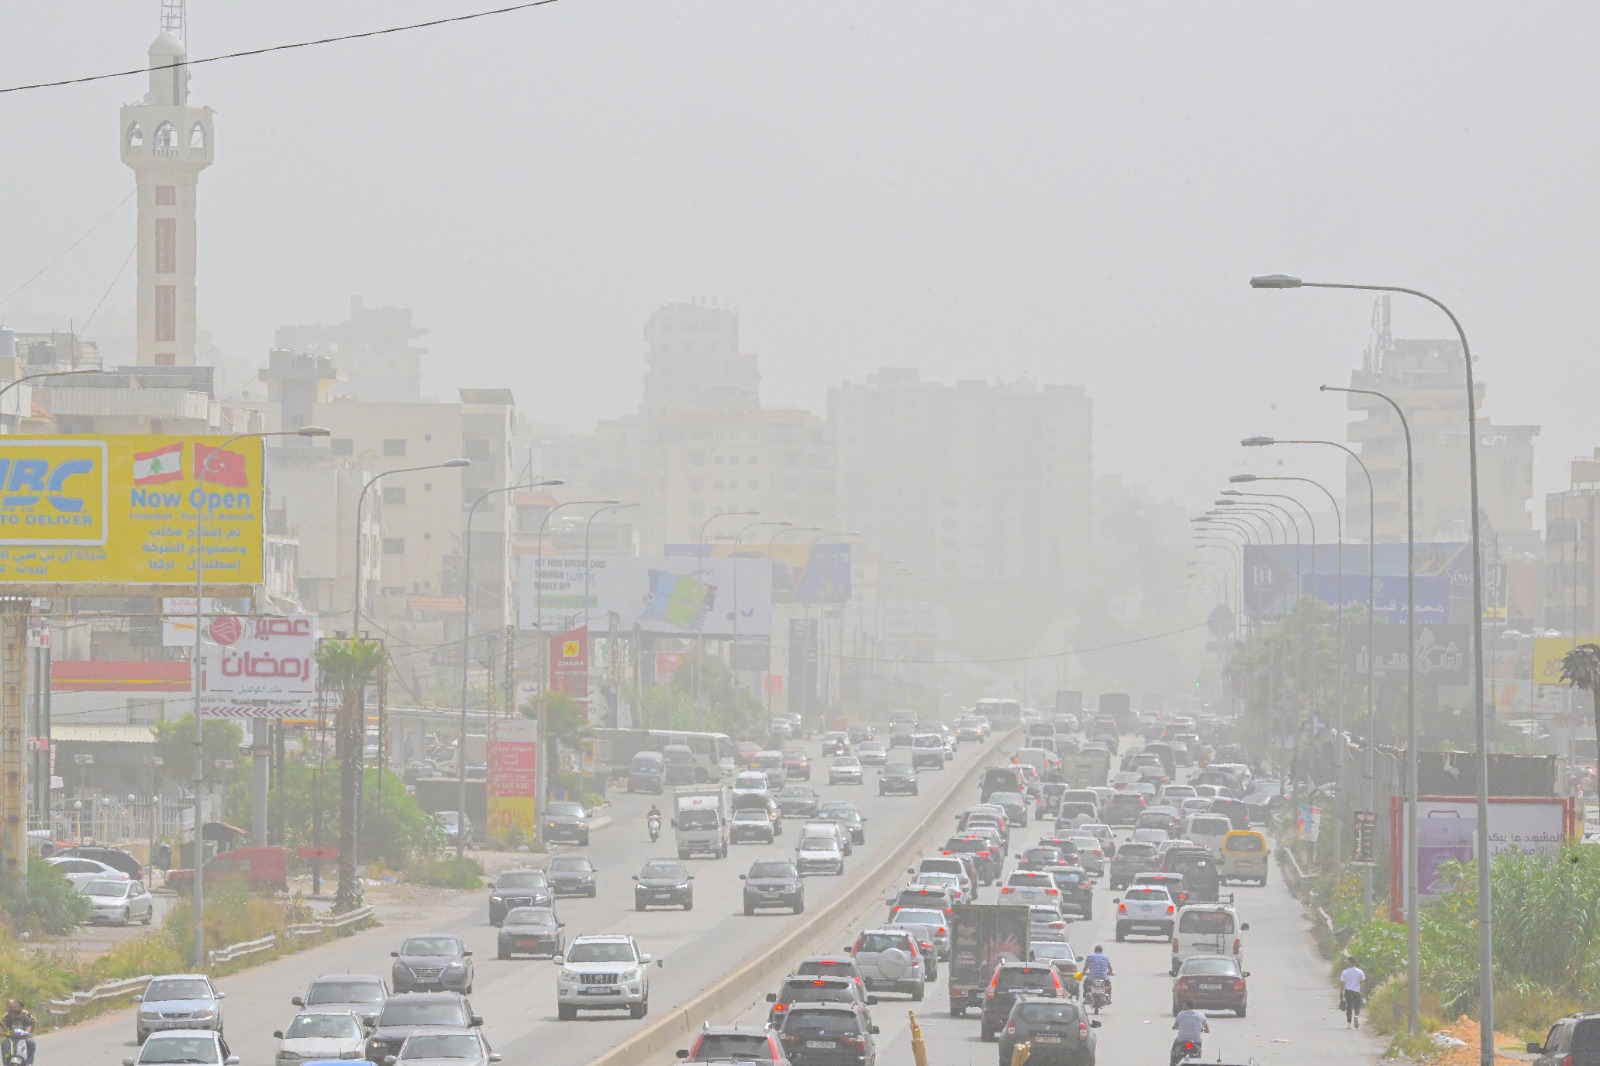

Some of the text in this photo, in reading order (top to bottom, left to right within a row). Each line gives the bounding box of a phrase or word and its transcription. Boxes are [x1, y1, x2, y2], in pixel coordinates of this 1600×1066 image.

[130, 487, 251, 514] Now Open
[25, 514, 93, 526] DELIVER
[180, 511, 215, 522] Turey
[148, 525, 182, 537] مكتب
[142, 541, 185, 555] الشركة
[565, 568, 597, 582] wink
[221, 651, 310, 682] رمضان
